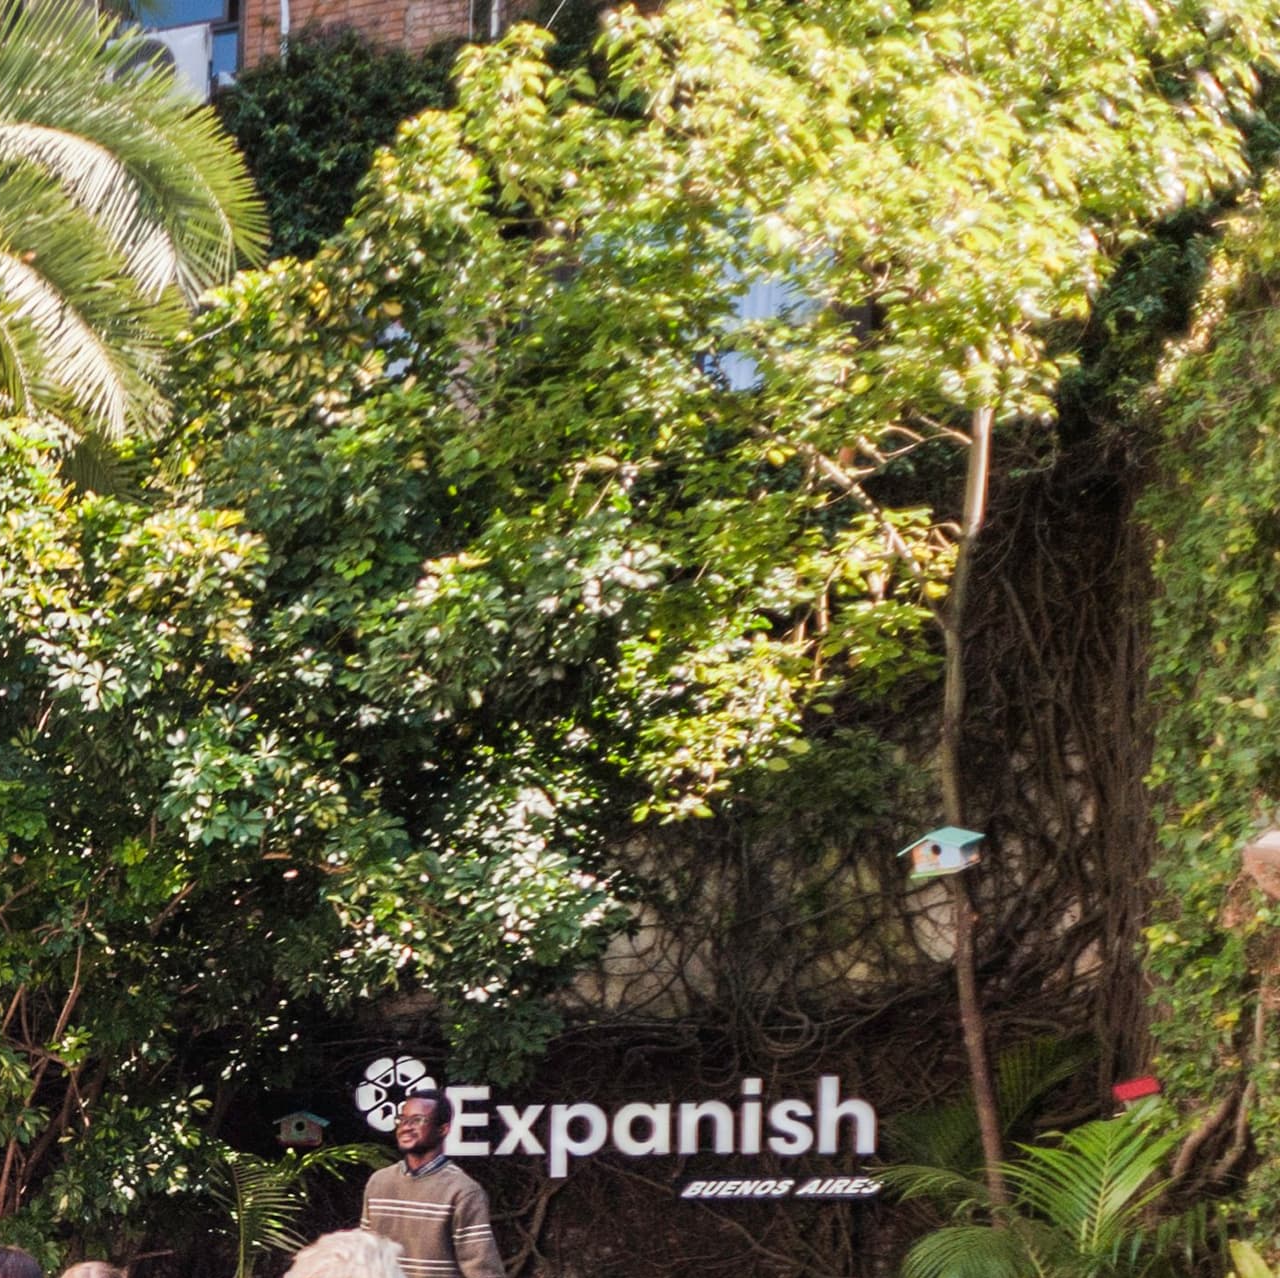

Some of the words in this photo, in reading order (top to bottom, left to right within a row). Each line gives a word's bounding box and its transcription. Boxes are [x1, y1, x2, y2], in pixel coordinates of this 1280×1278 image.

[443, 1075, 877, 1178] Expanish
[681, 1179, 795, 1198] BUENOS
[795, 1178, 883, 1196] AIRES
